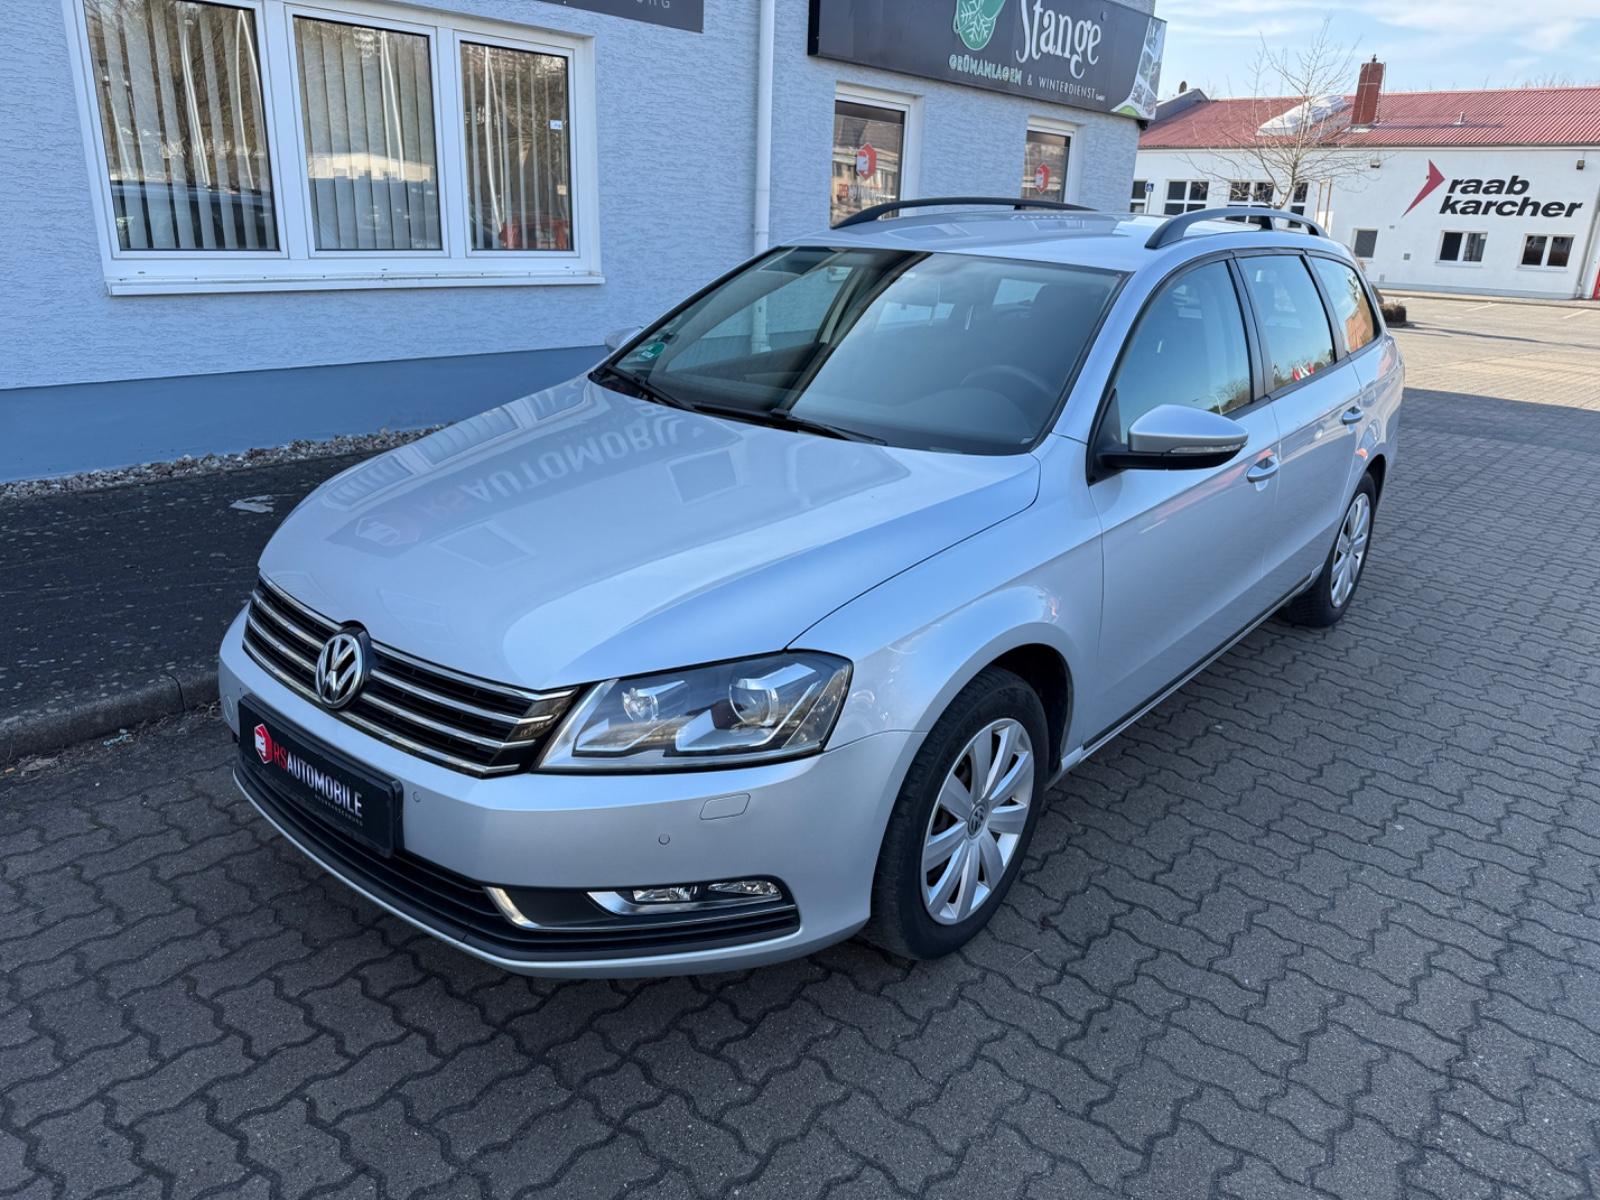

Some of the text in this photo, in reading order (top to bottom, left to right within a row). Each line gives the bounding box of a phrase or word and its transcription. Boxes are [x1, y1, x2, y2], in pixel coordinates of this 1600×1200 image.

[1026, 74, 1033, 87] &
[1038, 76, 1096, 101] WINTERDIENST
[1447, 175, 1530, 195] raab
[1439, 196, 1583, 218] karcher
